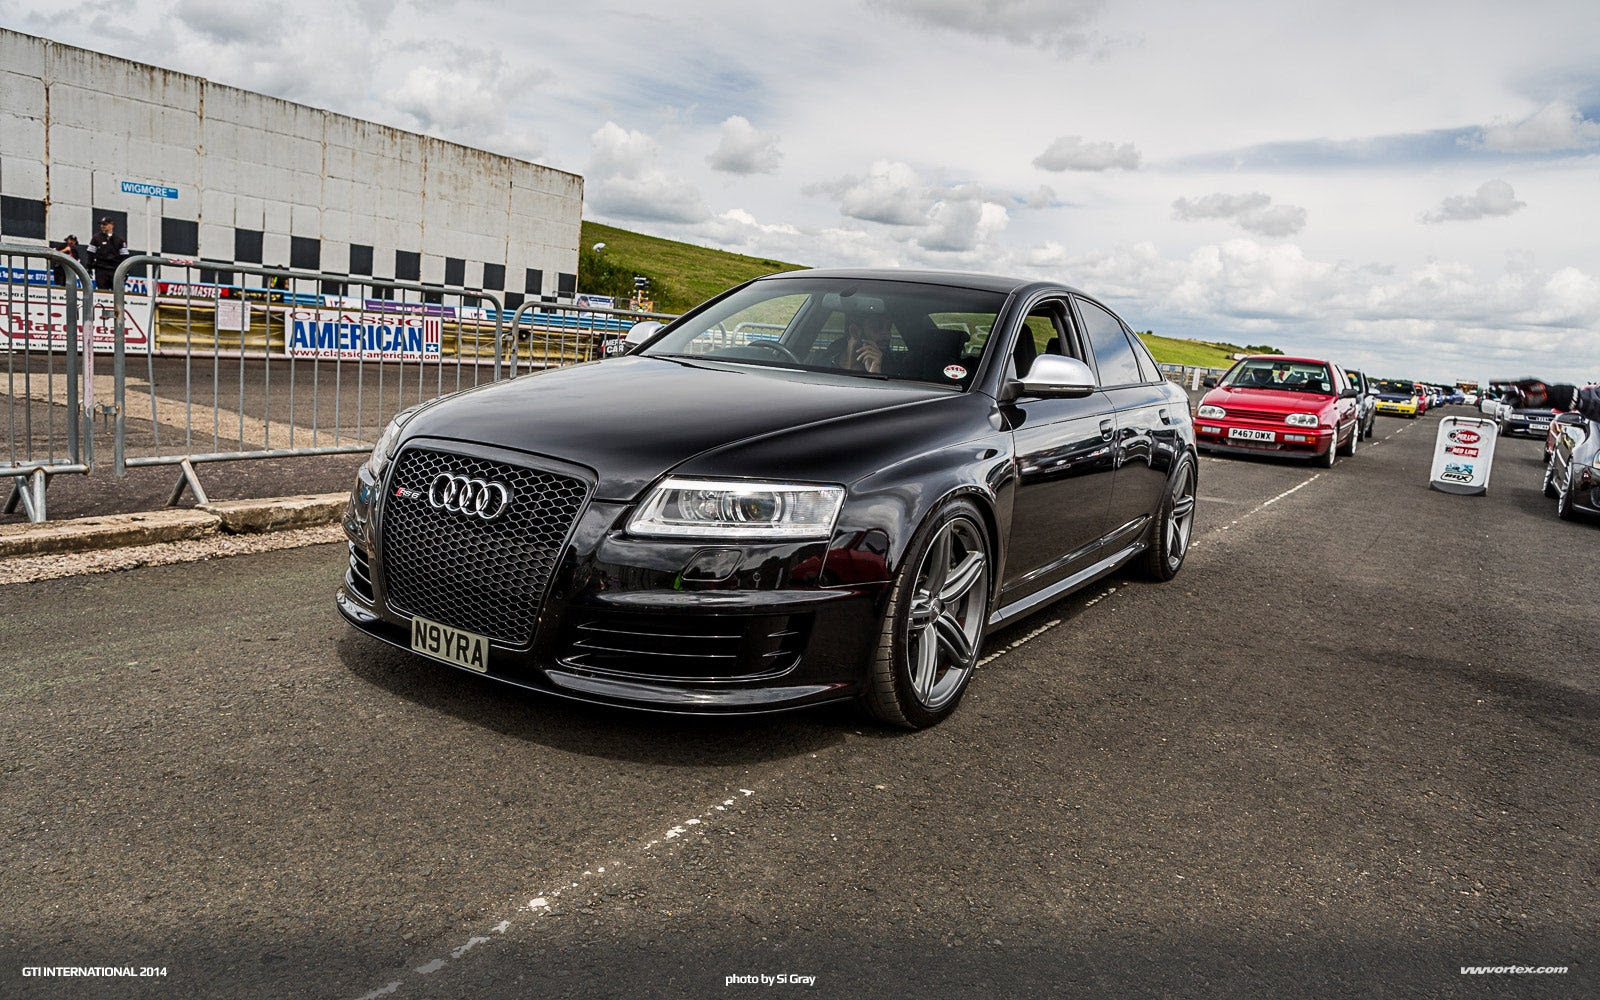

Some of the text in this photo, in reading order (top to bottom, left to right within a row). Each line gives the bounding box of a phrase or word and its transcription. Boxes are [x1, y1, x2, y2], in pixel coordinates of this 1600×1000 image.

[122, 182, 168, 197] WIGMORE
[289, 311, 423, 328] CLASSIC
[289, 321, 423, 352] AMERICAN
[289, 349, 440, 360] www.classic-american.com
[1232, 429, 1254, 438] P467
[414, 620, 484, 668] N9YRA
